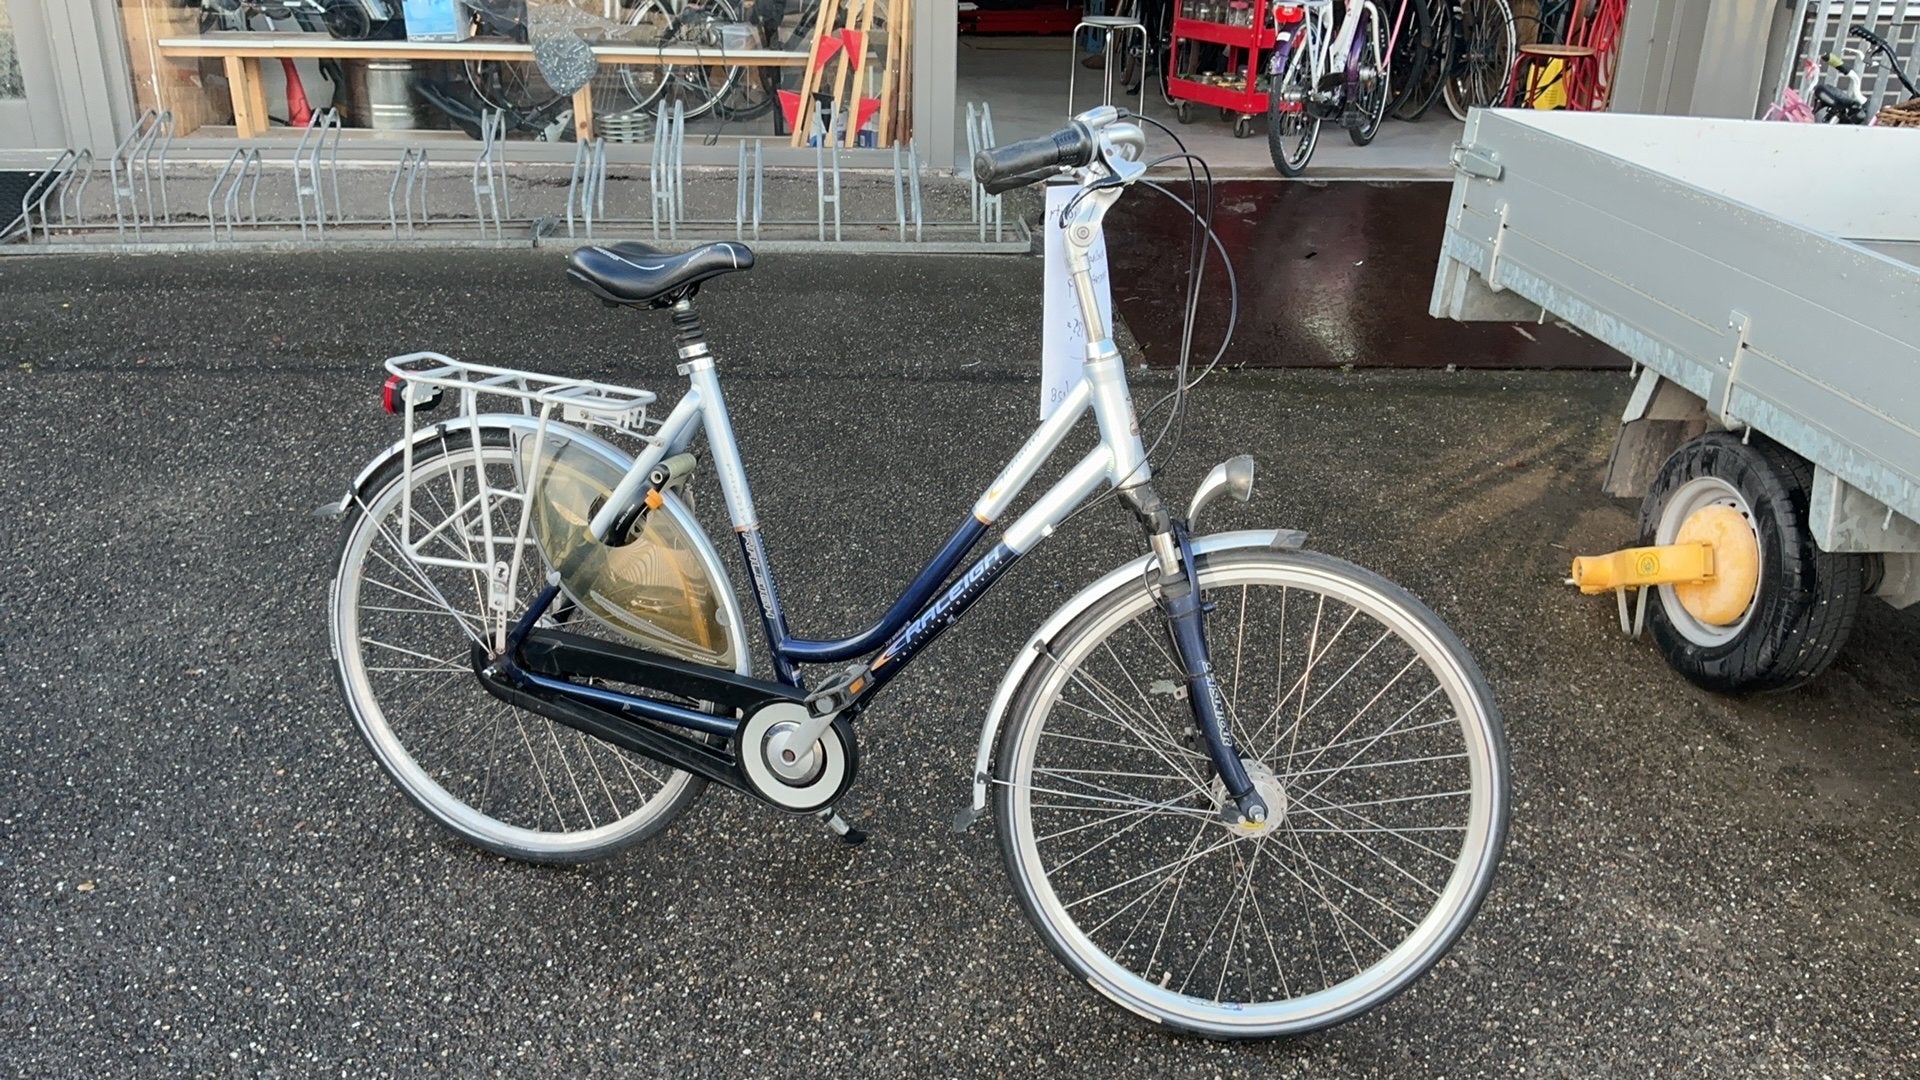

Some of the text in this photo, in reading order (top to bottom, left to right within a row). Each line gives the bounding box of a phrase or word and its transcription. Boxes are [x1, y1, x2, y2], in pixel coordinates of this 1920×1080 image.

[742, 532, 775, 618] RALEIGH
[905, 543, 1003, 643] RALEIGH
[1209, 687, 1233, 746] SUNTOUR
